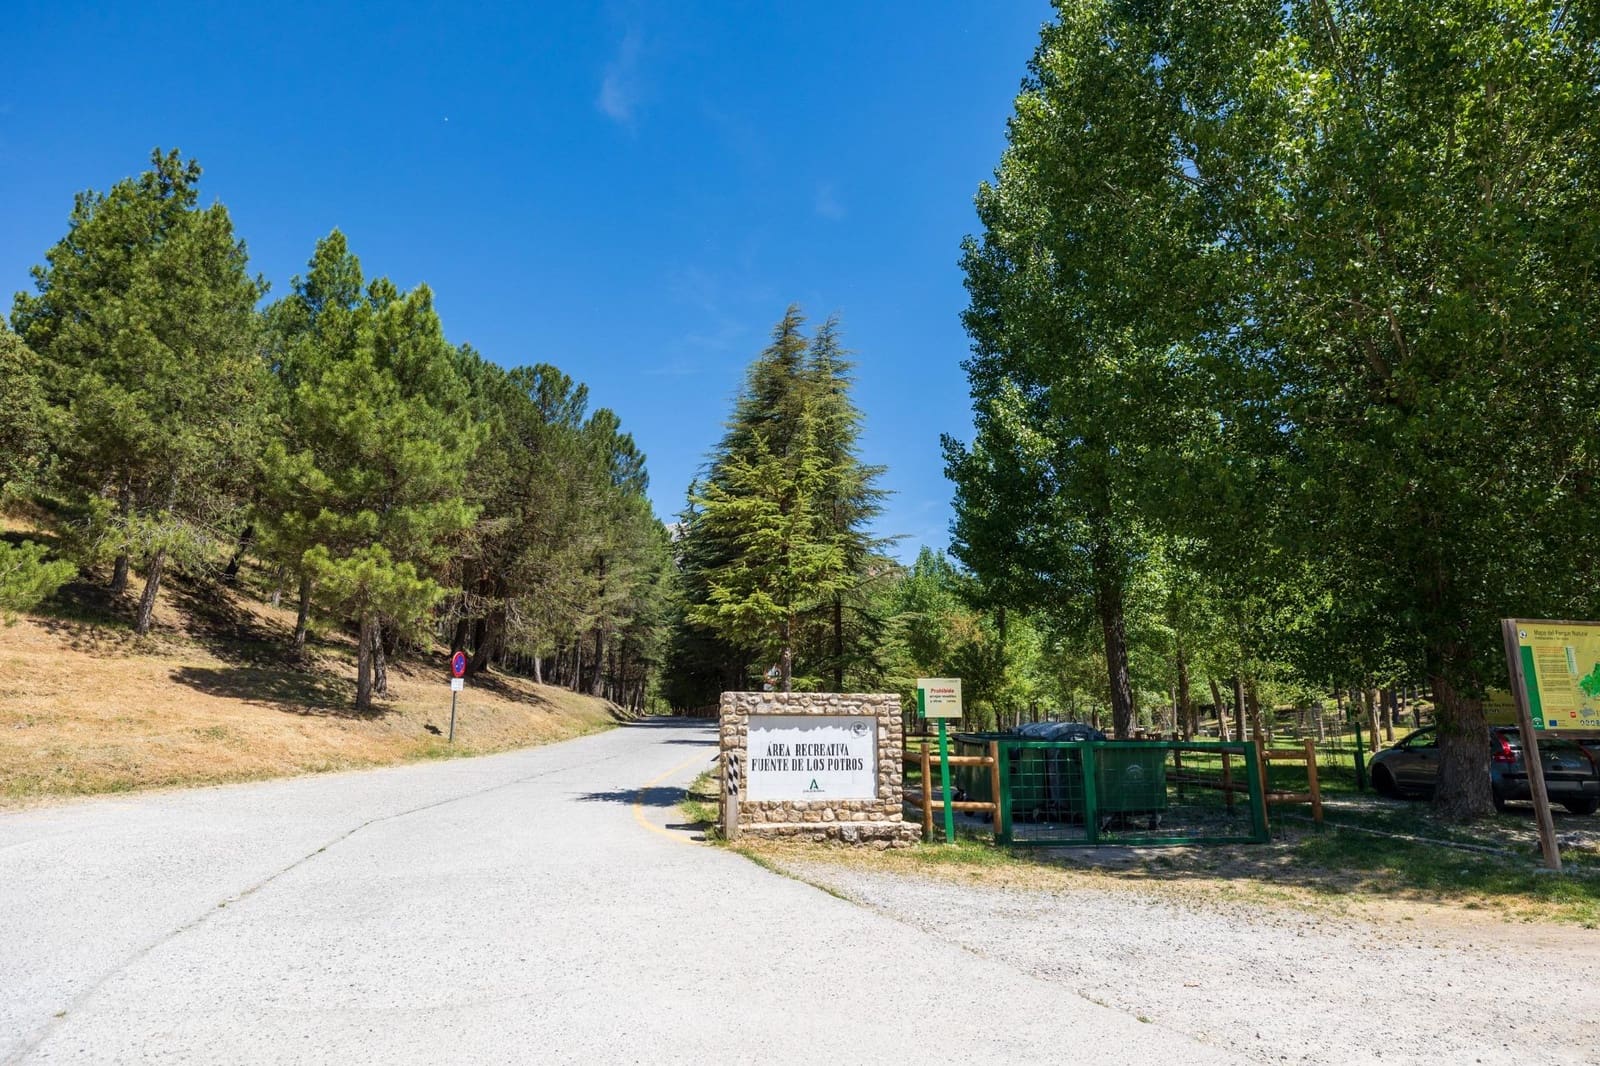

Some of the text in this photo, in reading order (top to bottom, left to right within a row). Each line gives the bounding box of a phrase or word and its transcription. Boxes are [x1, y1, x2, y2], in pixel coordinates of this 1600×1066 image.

[795, 743, 849, 757] RECREATIVA
[751, 757, 863, 771] FUENTE DE LOS POTROS
